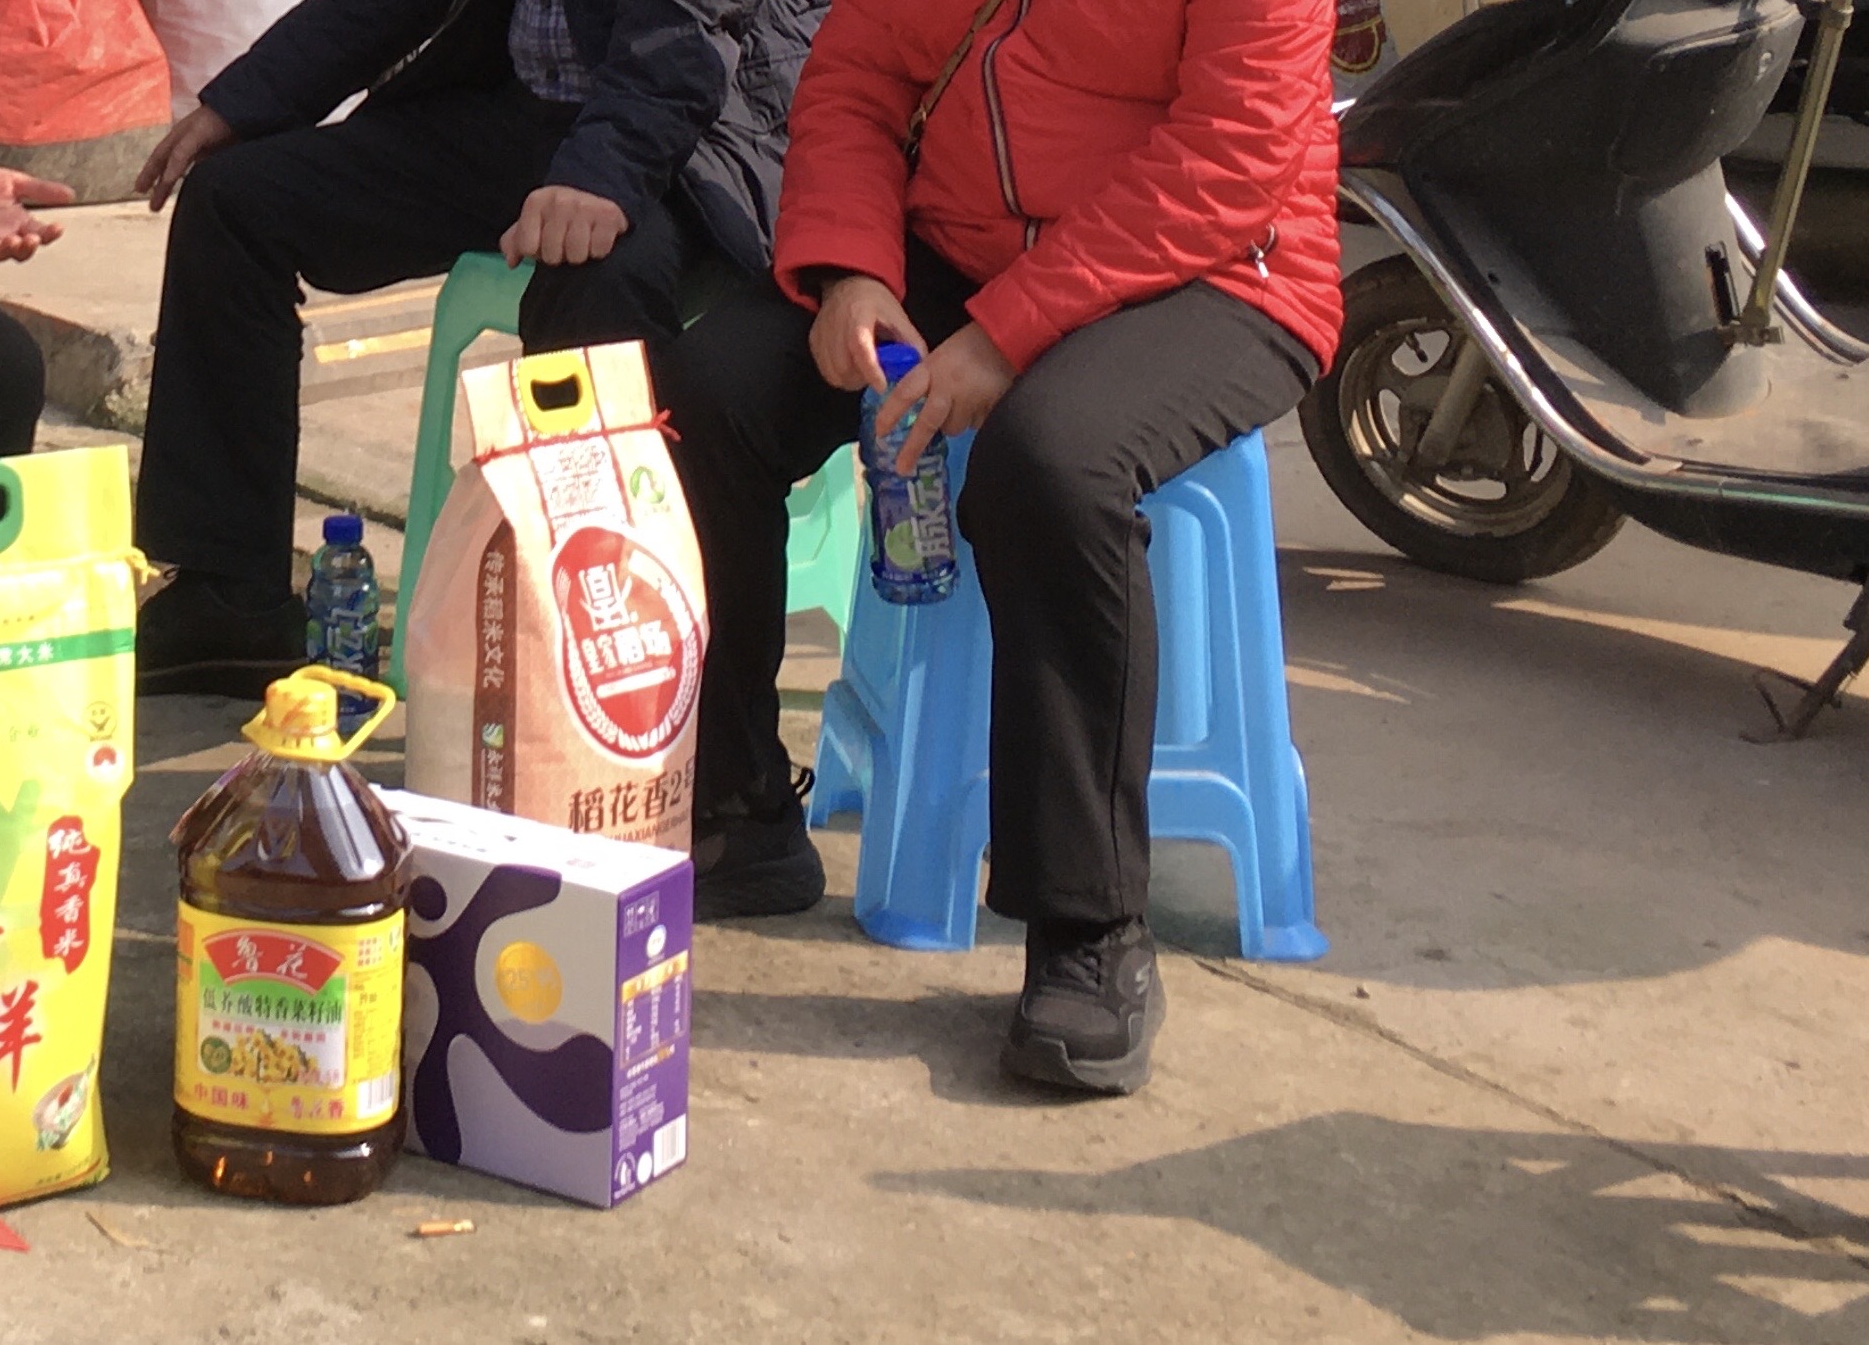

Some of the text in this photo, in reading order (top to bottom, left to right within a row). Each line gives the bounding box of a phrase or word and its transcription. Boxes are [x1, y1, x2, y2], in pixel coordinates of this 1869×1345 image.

[48, 828, 93, 957] 纯真香米
[232, 935, 308, 979] 鲁花
[203, 987, 342, 1024] 低芥酸特香菜籽油
[194, 1083, 249, 1110] 中国味
